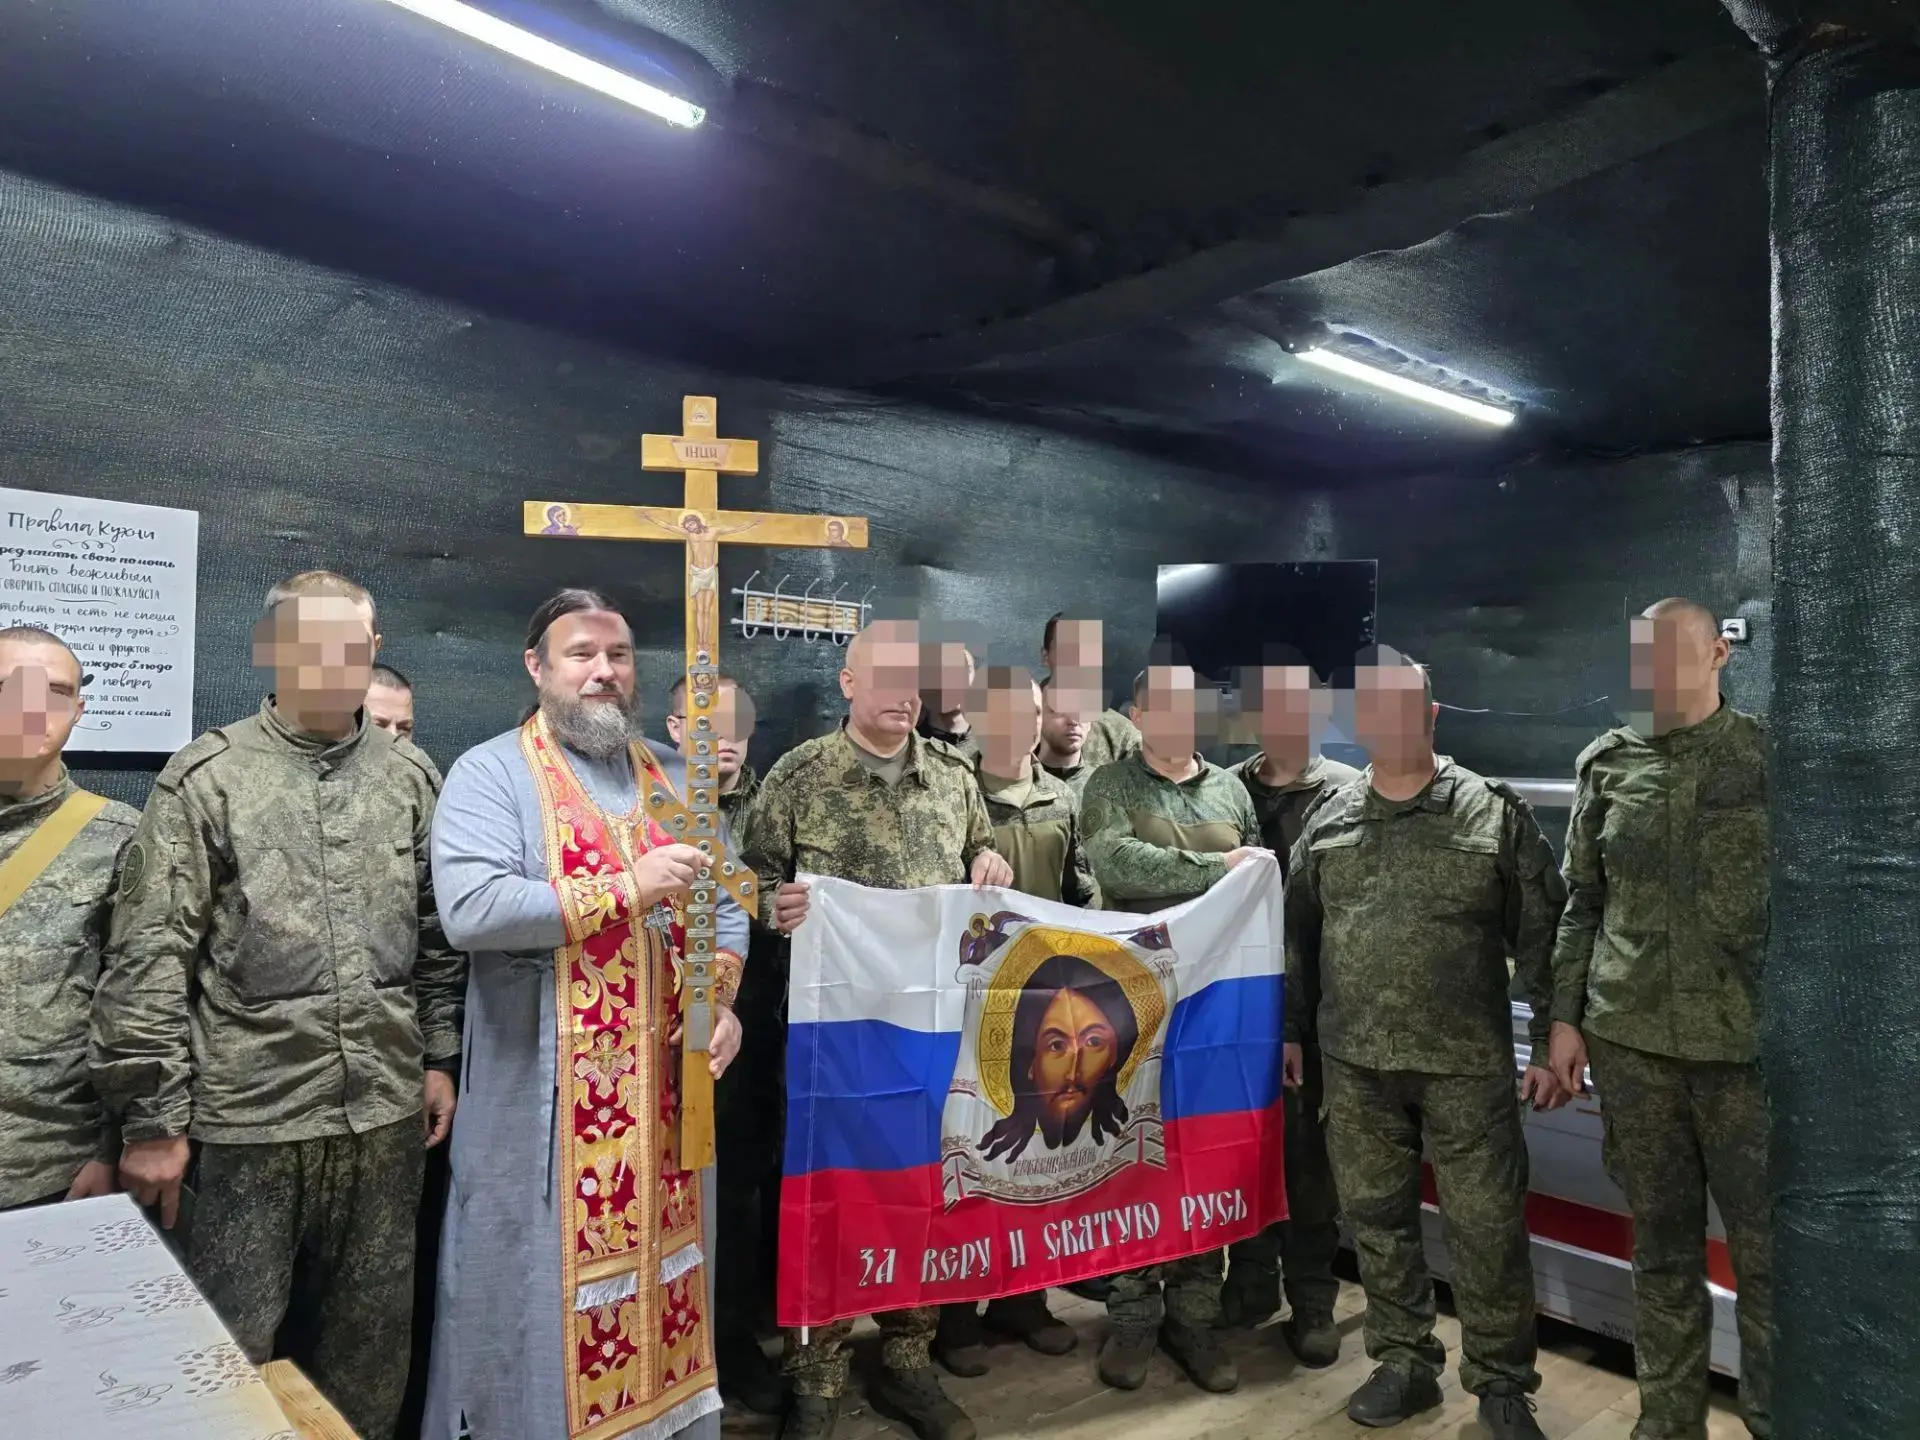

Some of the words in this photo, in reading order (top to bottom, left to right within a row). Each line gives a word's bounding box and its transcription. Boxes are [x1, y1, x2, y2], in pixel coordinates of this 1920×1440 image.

[8, 506, 94, 536] Правила
[99, 520, 155, 543] Кухни
[82, 553, 116, 564] свою
[120, 557, 175, 568] помощь
[9, 559, 58, 575] Быть
[67, 564, 152, 583] вежливым
[50, 582, 88, 595] СПАСИБО
[92, 585, 98, 596] И
[101, 586, 160, 600] ПОЖАЛУЙСТА
[77, 608, 107, 617] есть
[115, 611, 129, 619] не
[135, 612, 176, 622] спеша
[54, 622, 85, 638] руки
[90, 625, 122, 639] перед
[127, 627, 153, 639] едой
[109, 643, 151, 658] фруктов
[128, 660, 173, 674] блюдо
[102, 670, 152, 689] повара
[112, 695, 139, 703] столом
[858, 1248, 895, 1287] ЗА
[920, 1237, 992, 1284] ВЕРУ
[1009, 1229, 1026, 1269] И
[1043, 1201, 1162, 1260] СВЯТУЮ
[1181, 1188, 1248, 1232] РУСЬ
